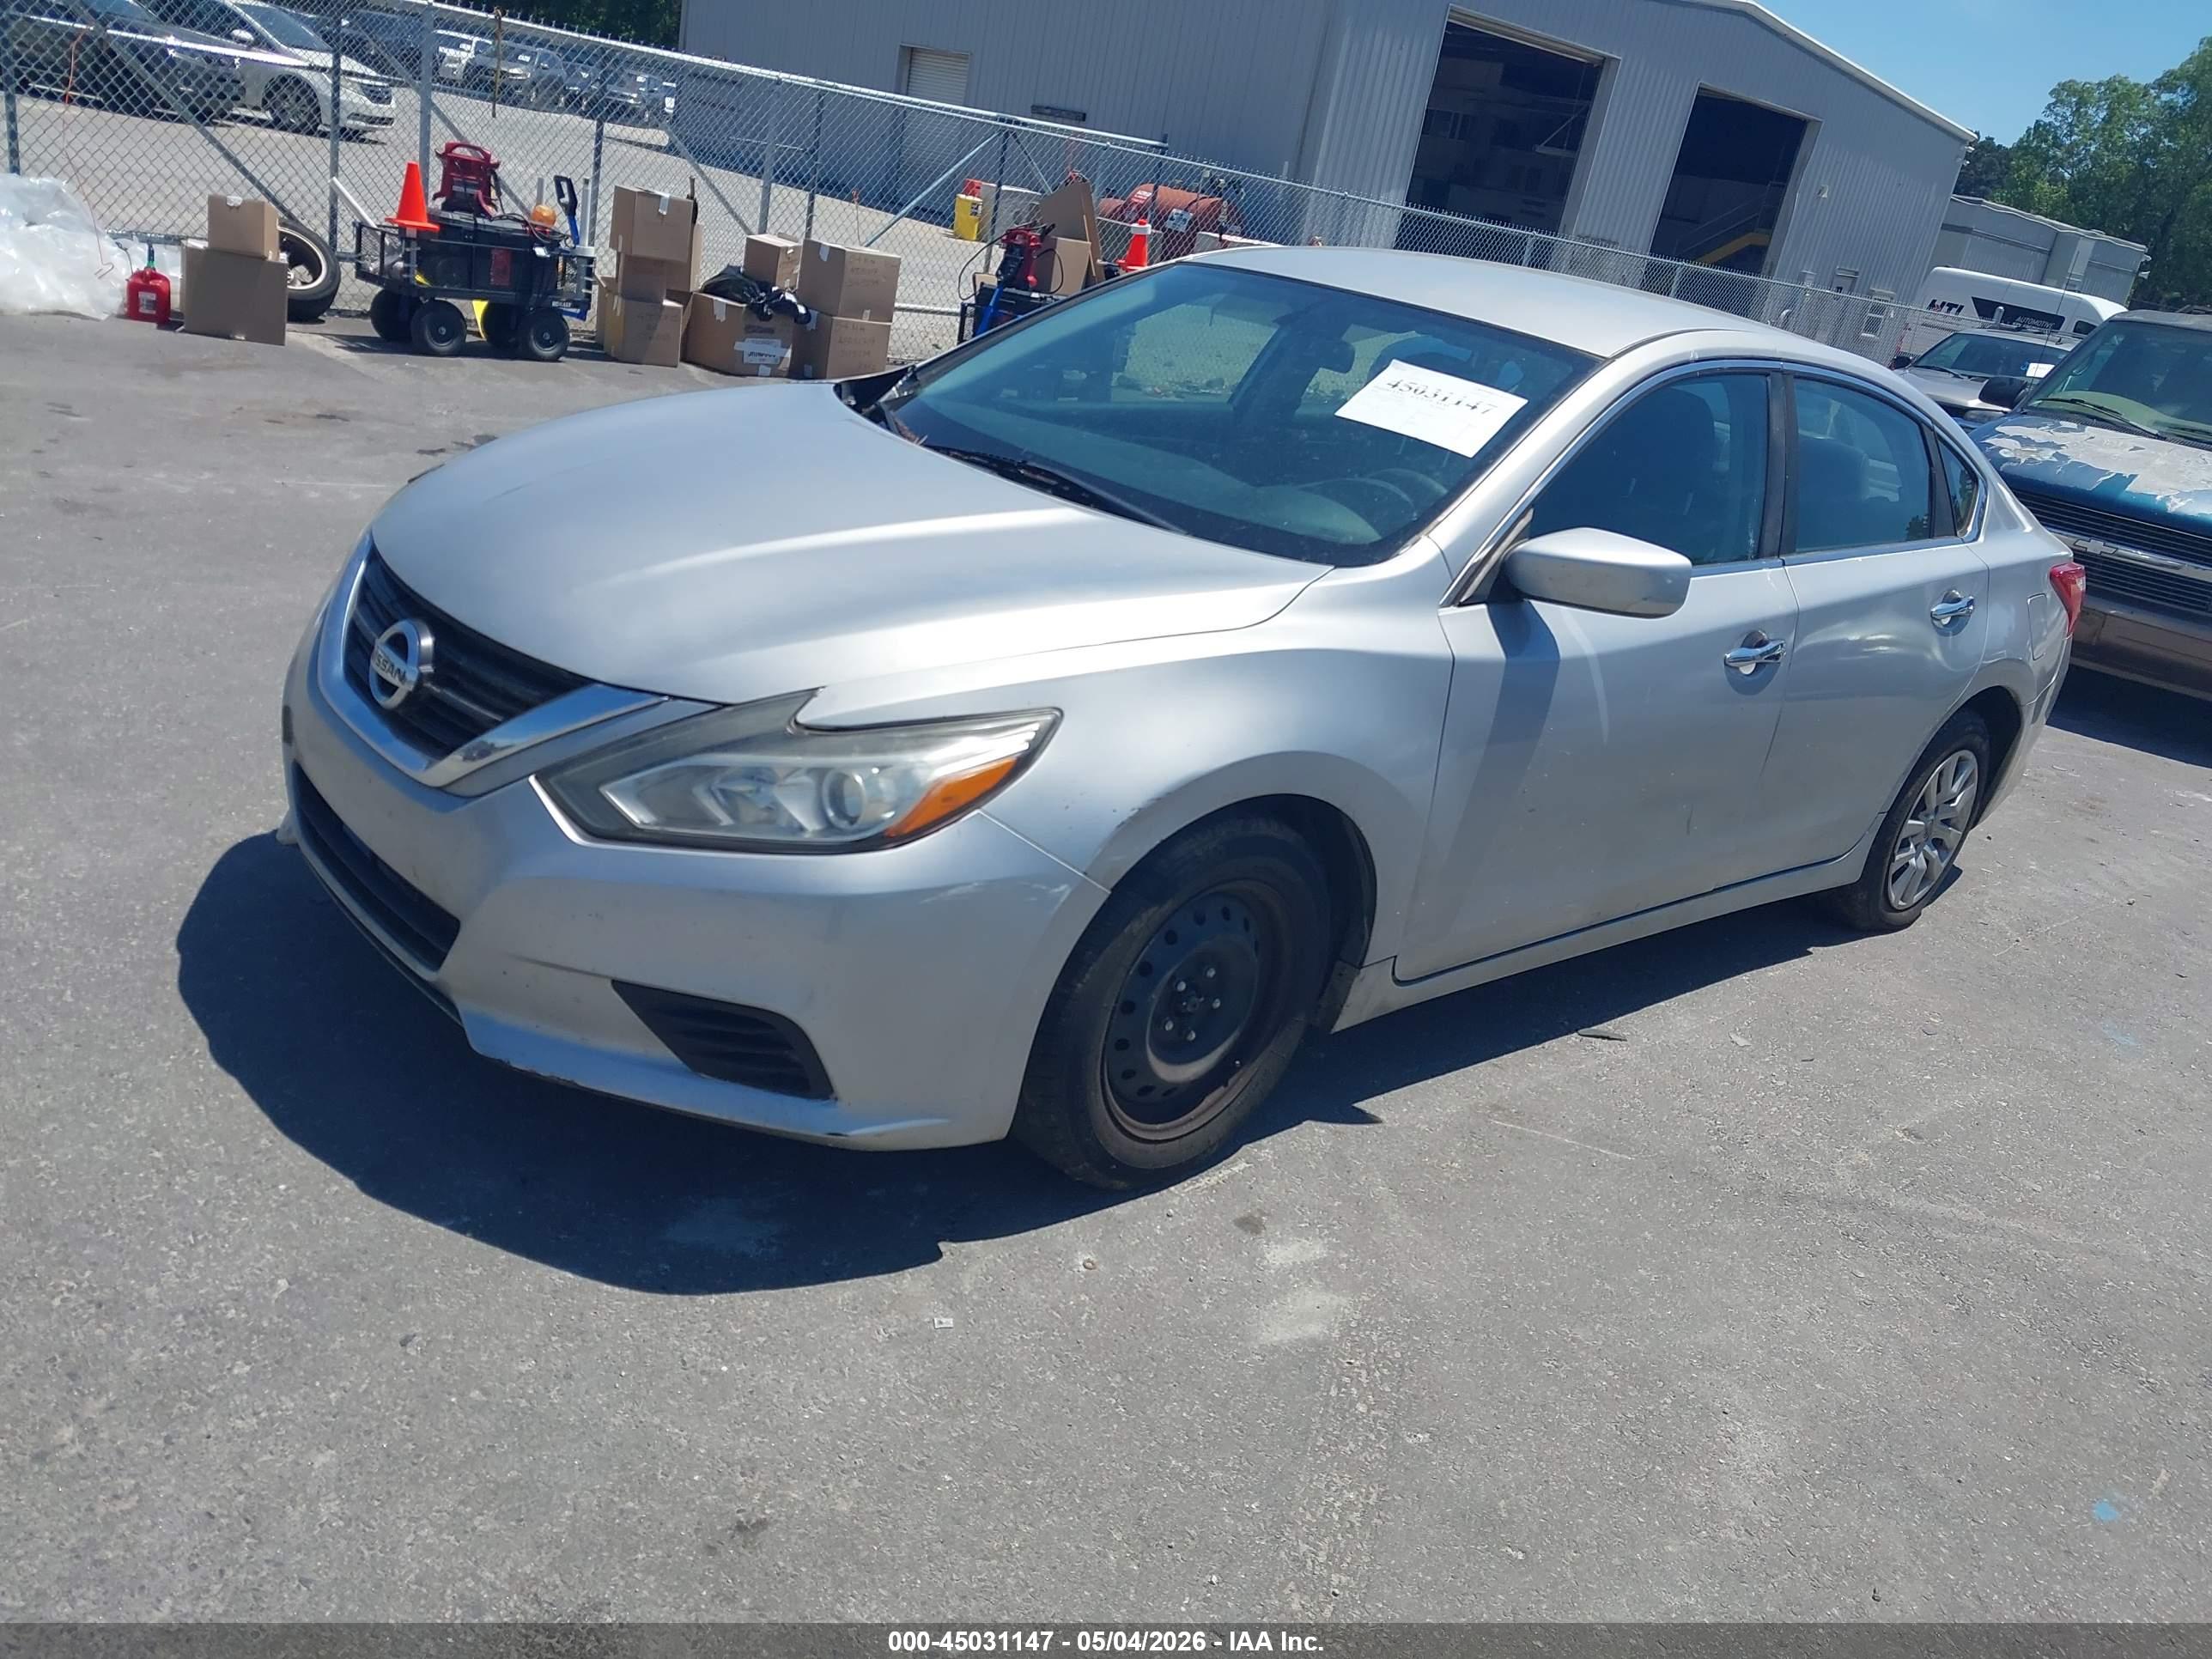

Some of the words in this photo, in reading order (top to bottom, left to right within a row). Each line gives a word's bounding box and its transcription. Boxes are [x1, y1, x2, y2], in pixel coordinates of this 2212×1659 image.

[2015, 316, 2056, 328] AUTOMOTIVE
[1387, 379, 1498, 414] 45031147
[375, 653, 407, 684] SSAN
